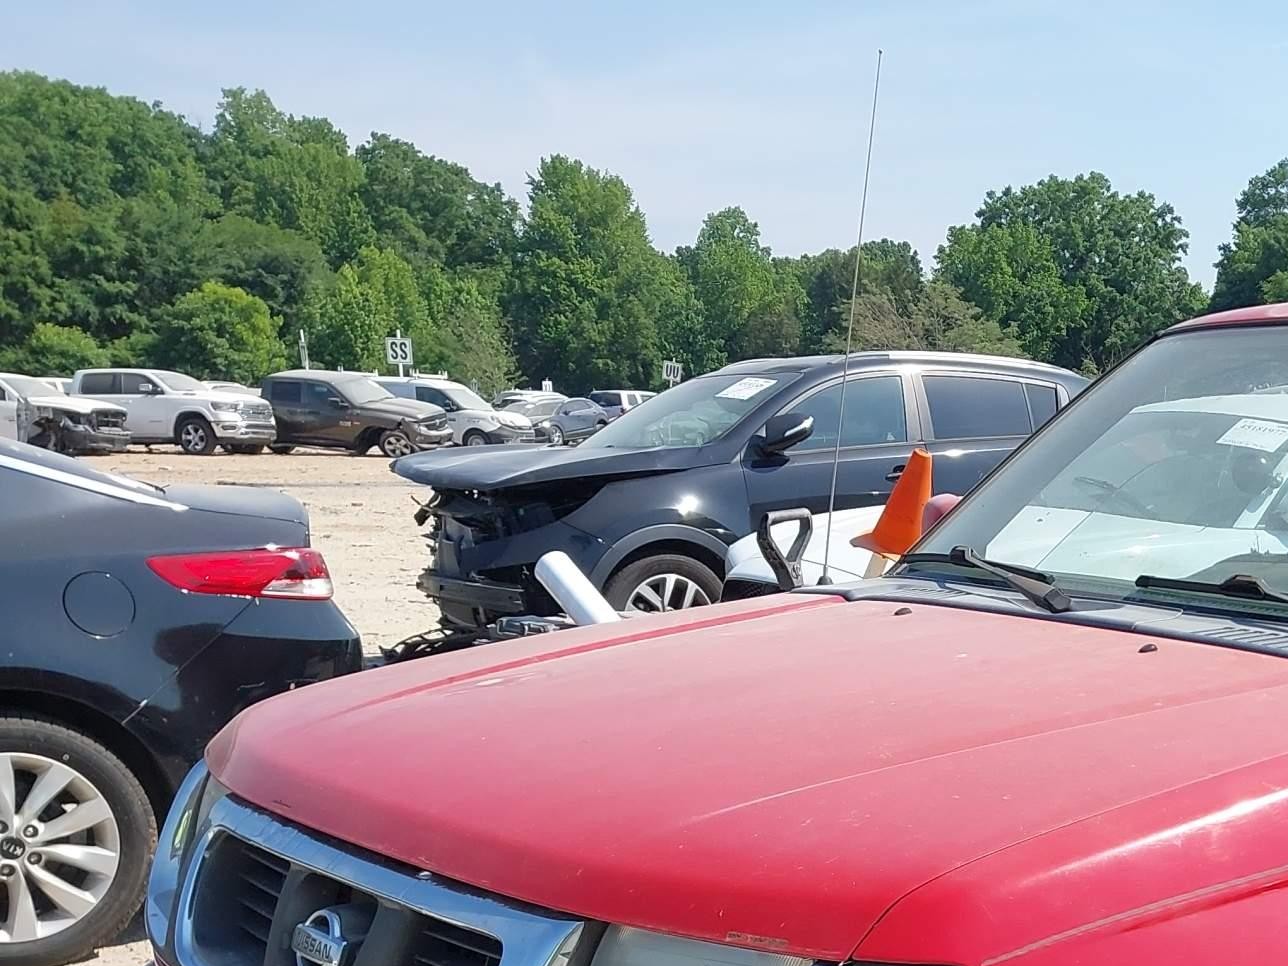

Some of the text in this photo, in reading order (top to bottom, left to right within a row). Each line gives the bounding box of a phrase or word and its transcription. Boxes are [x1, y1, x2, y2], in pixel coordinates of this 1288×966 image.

[390, 341, 408, 360] SS
[665, 364, 680, 379] UU
[2, 840, 23, 856] KIA
[296, 930, 332, 960] NISSAN
